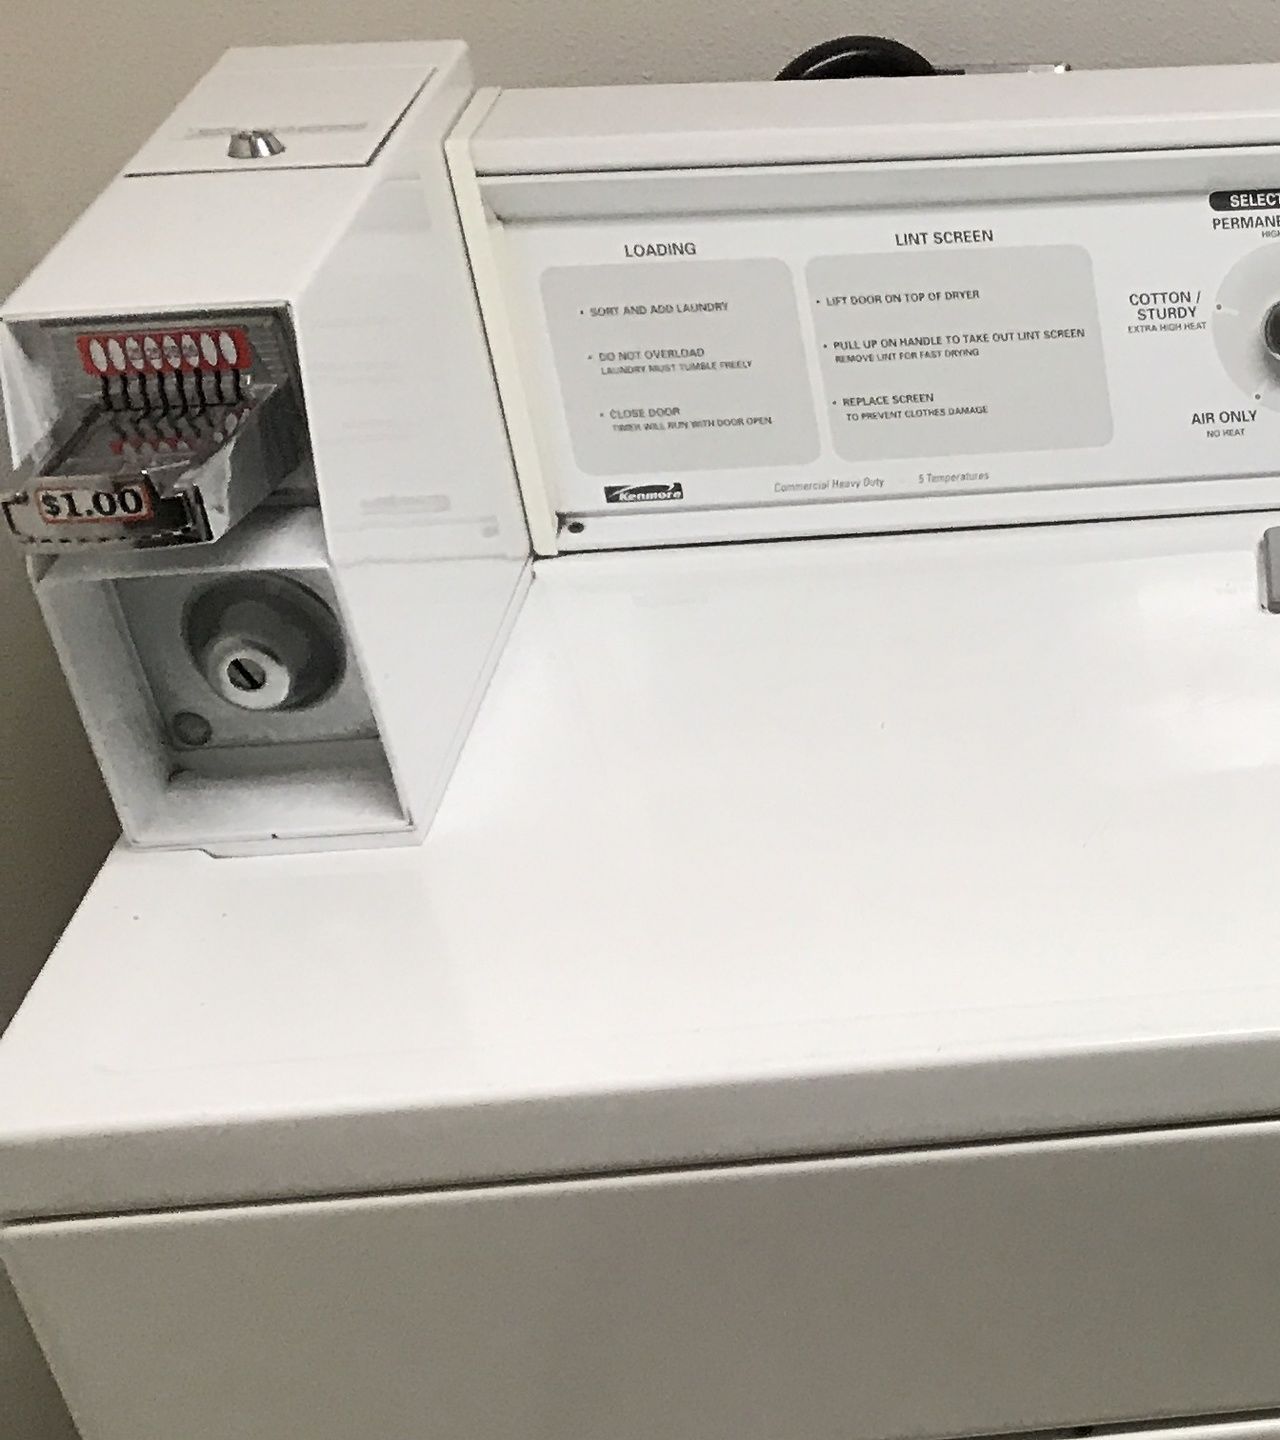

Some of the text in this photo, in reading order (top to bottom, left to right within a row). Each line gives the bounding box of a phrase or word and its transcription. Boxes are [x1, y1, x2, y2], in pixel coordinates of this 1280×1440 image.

[895, 230, 993, 246] LINT SCREEN
[624, 243, 697, 258] LOADING
[826, 290, 980, 307] LIFT DOOR ON TOP OF DRYER
[1129, 292, 1191, 306] COTTON
[591, 302, 728, 317] SORT AND ADD LAUNDRY
[1138, 306, 1197, 321] STURDY
[1128, 322, 1206, 334] EXTRA HIGH HEAT
[834, 329, 1085, 350] PULL UP ON HANDLE TO TAKE OUT LINT SCREEN
[600, 348, 705, 361] DO NOT OVERLOAD
[835, 348, 979, 363] REMOVE LINT FOR FAST DRYING
[601, 360, 752, 375] LAUNDRY MUST TUMBLE FREELY
[843, 394, 934, 407] REPLACE SCREEN
[610, 407, 680, 419] CLOSE DOOR
[847, 406, 988, 421] TO PREVENT CLOTHES DAMAGE
[1192, 410, 1257, 425] AIR ONLY
[1207, 428, 1245, 438] NO HEAT
[775, 477, 884, 493] Commercial Heavy Duty
[919, 472, 989, 484] 5 Temperatures
[616, 487, 683, 501] Kenmore
[41, 488, 145, 517] $1.00
